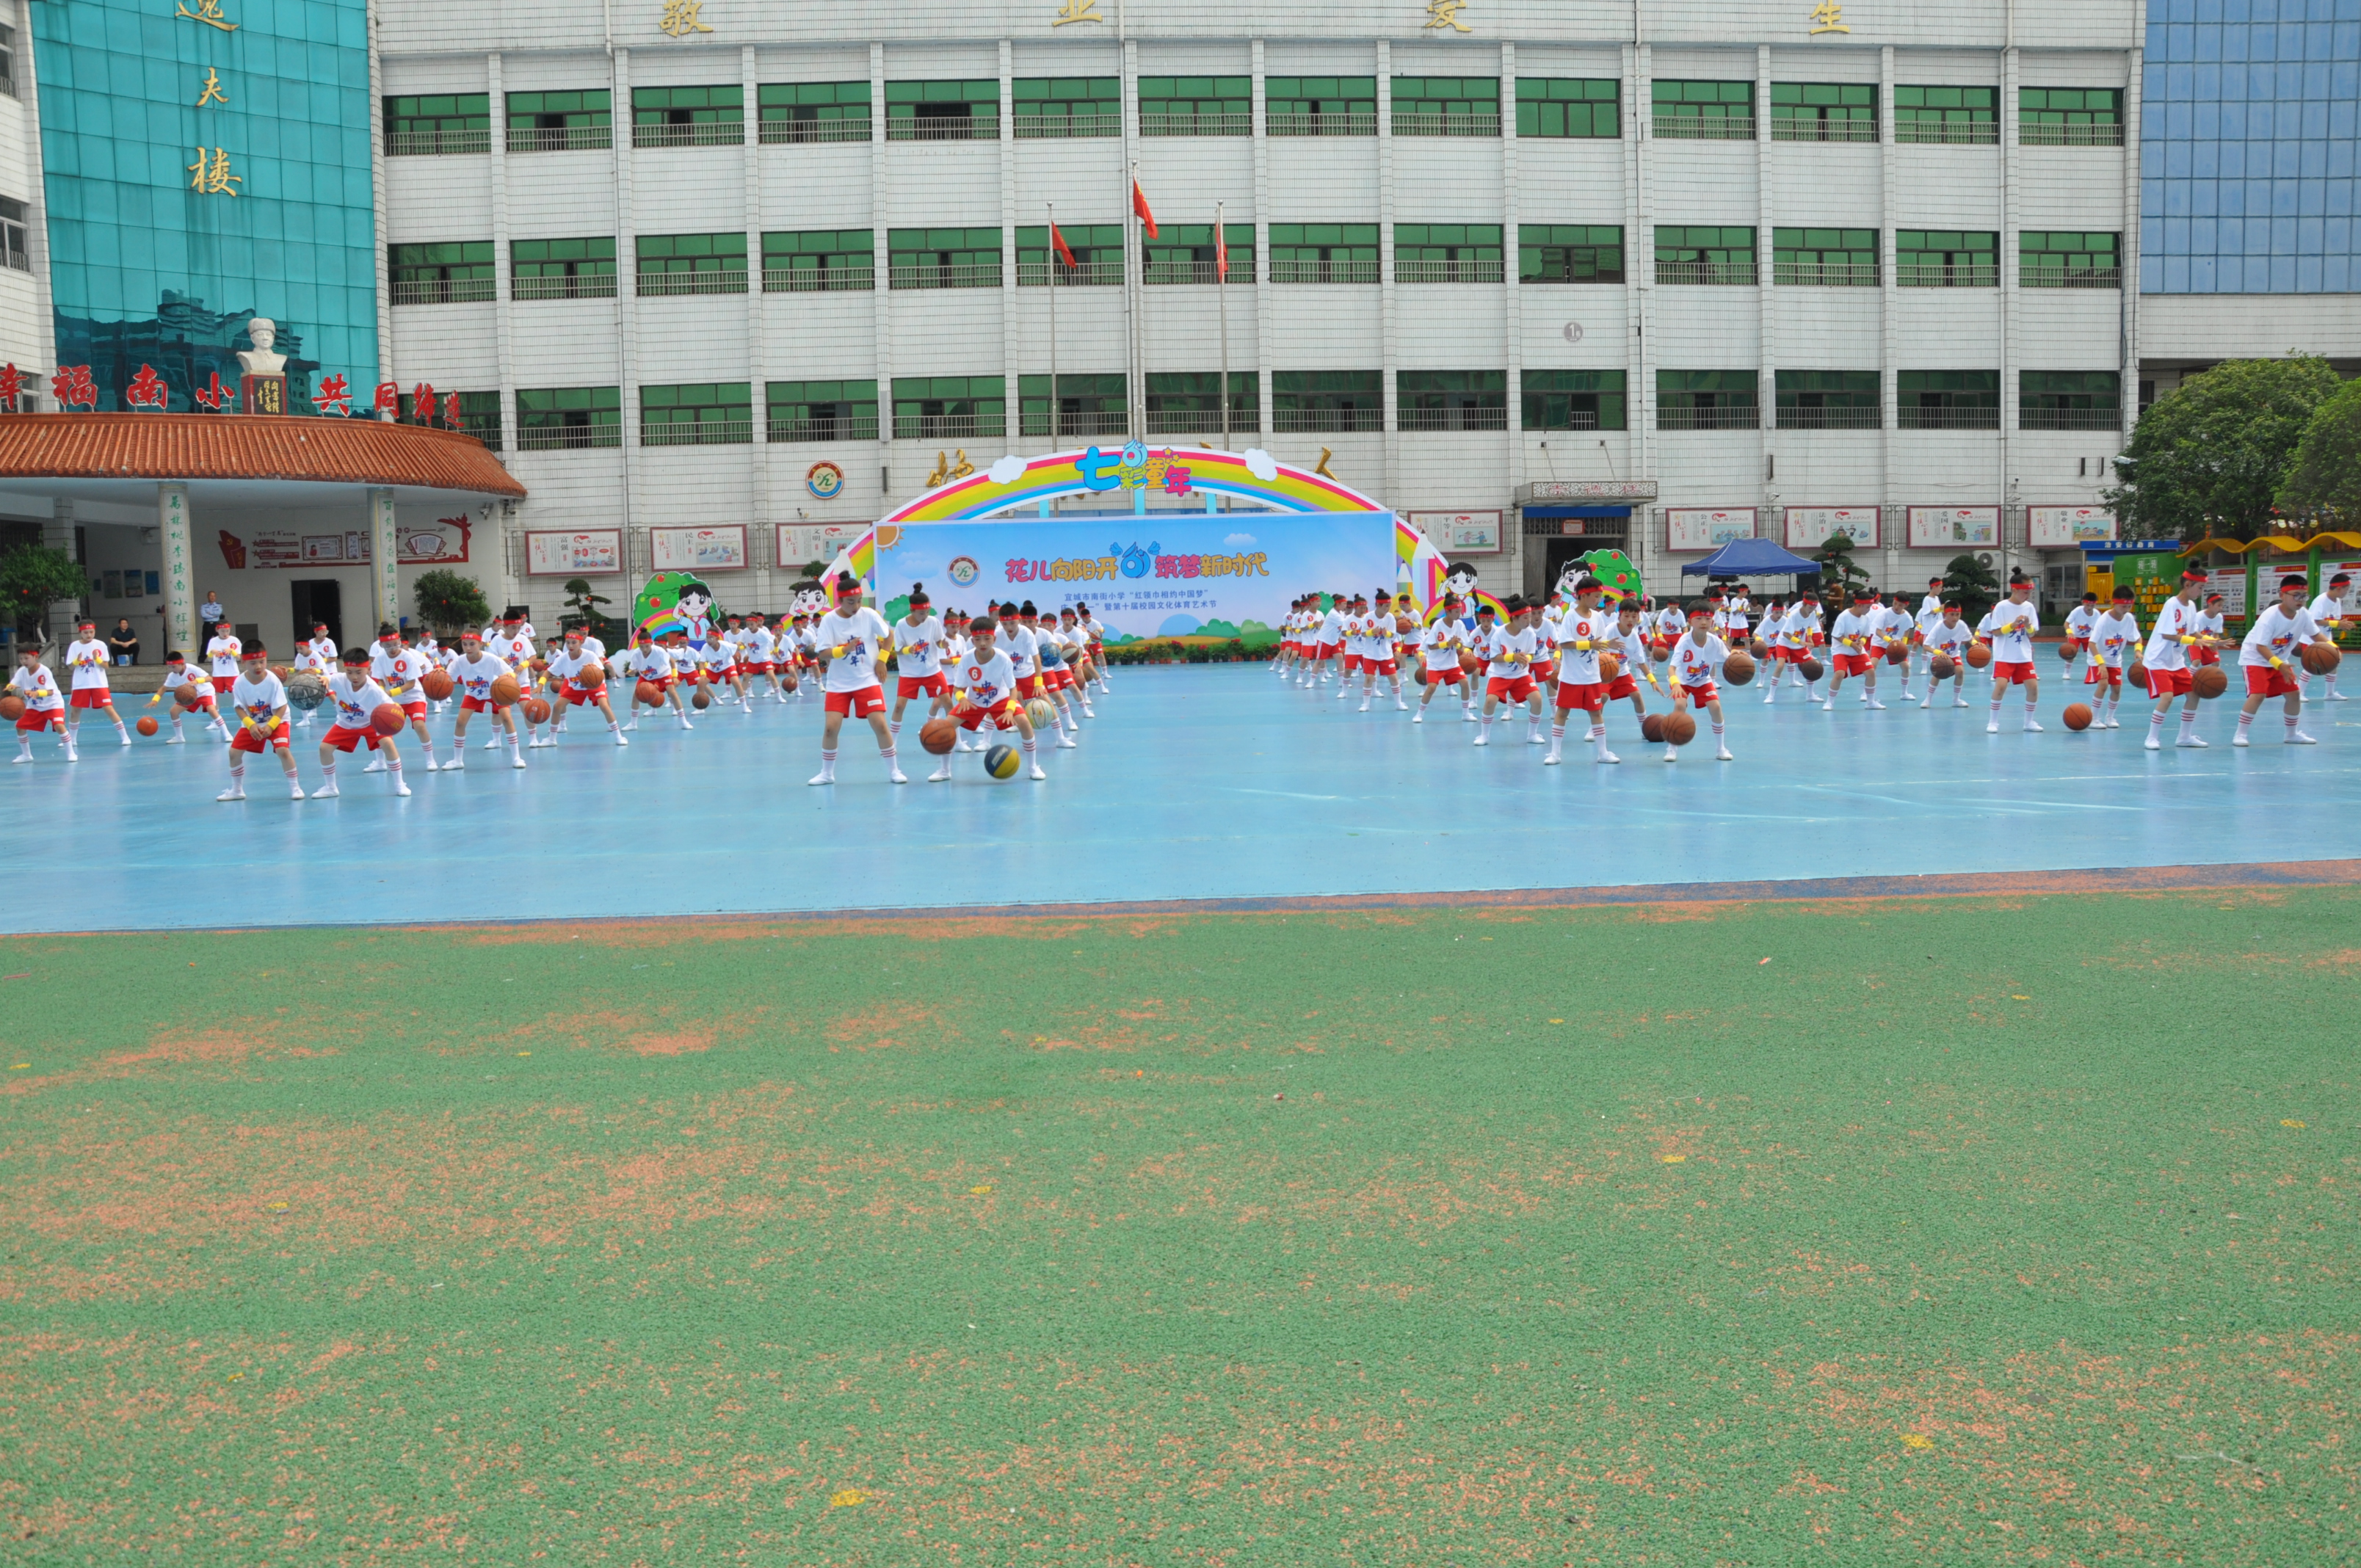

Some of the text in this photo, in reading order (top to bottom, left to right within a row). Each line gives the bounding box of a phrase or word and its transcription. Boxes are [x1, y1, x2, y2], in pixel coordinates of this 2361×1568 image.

[1075, 446, 1192, 497] 七彩童年
[812, 529, 820, 541] 文明
[1005, 557, 1118, 583] 花儿向阳开
[1155, 552, 1269, 578] 筑梦新时代
